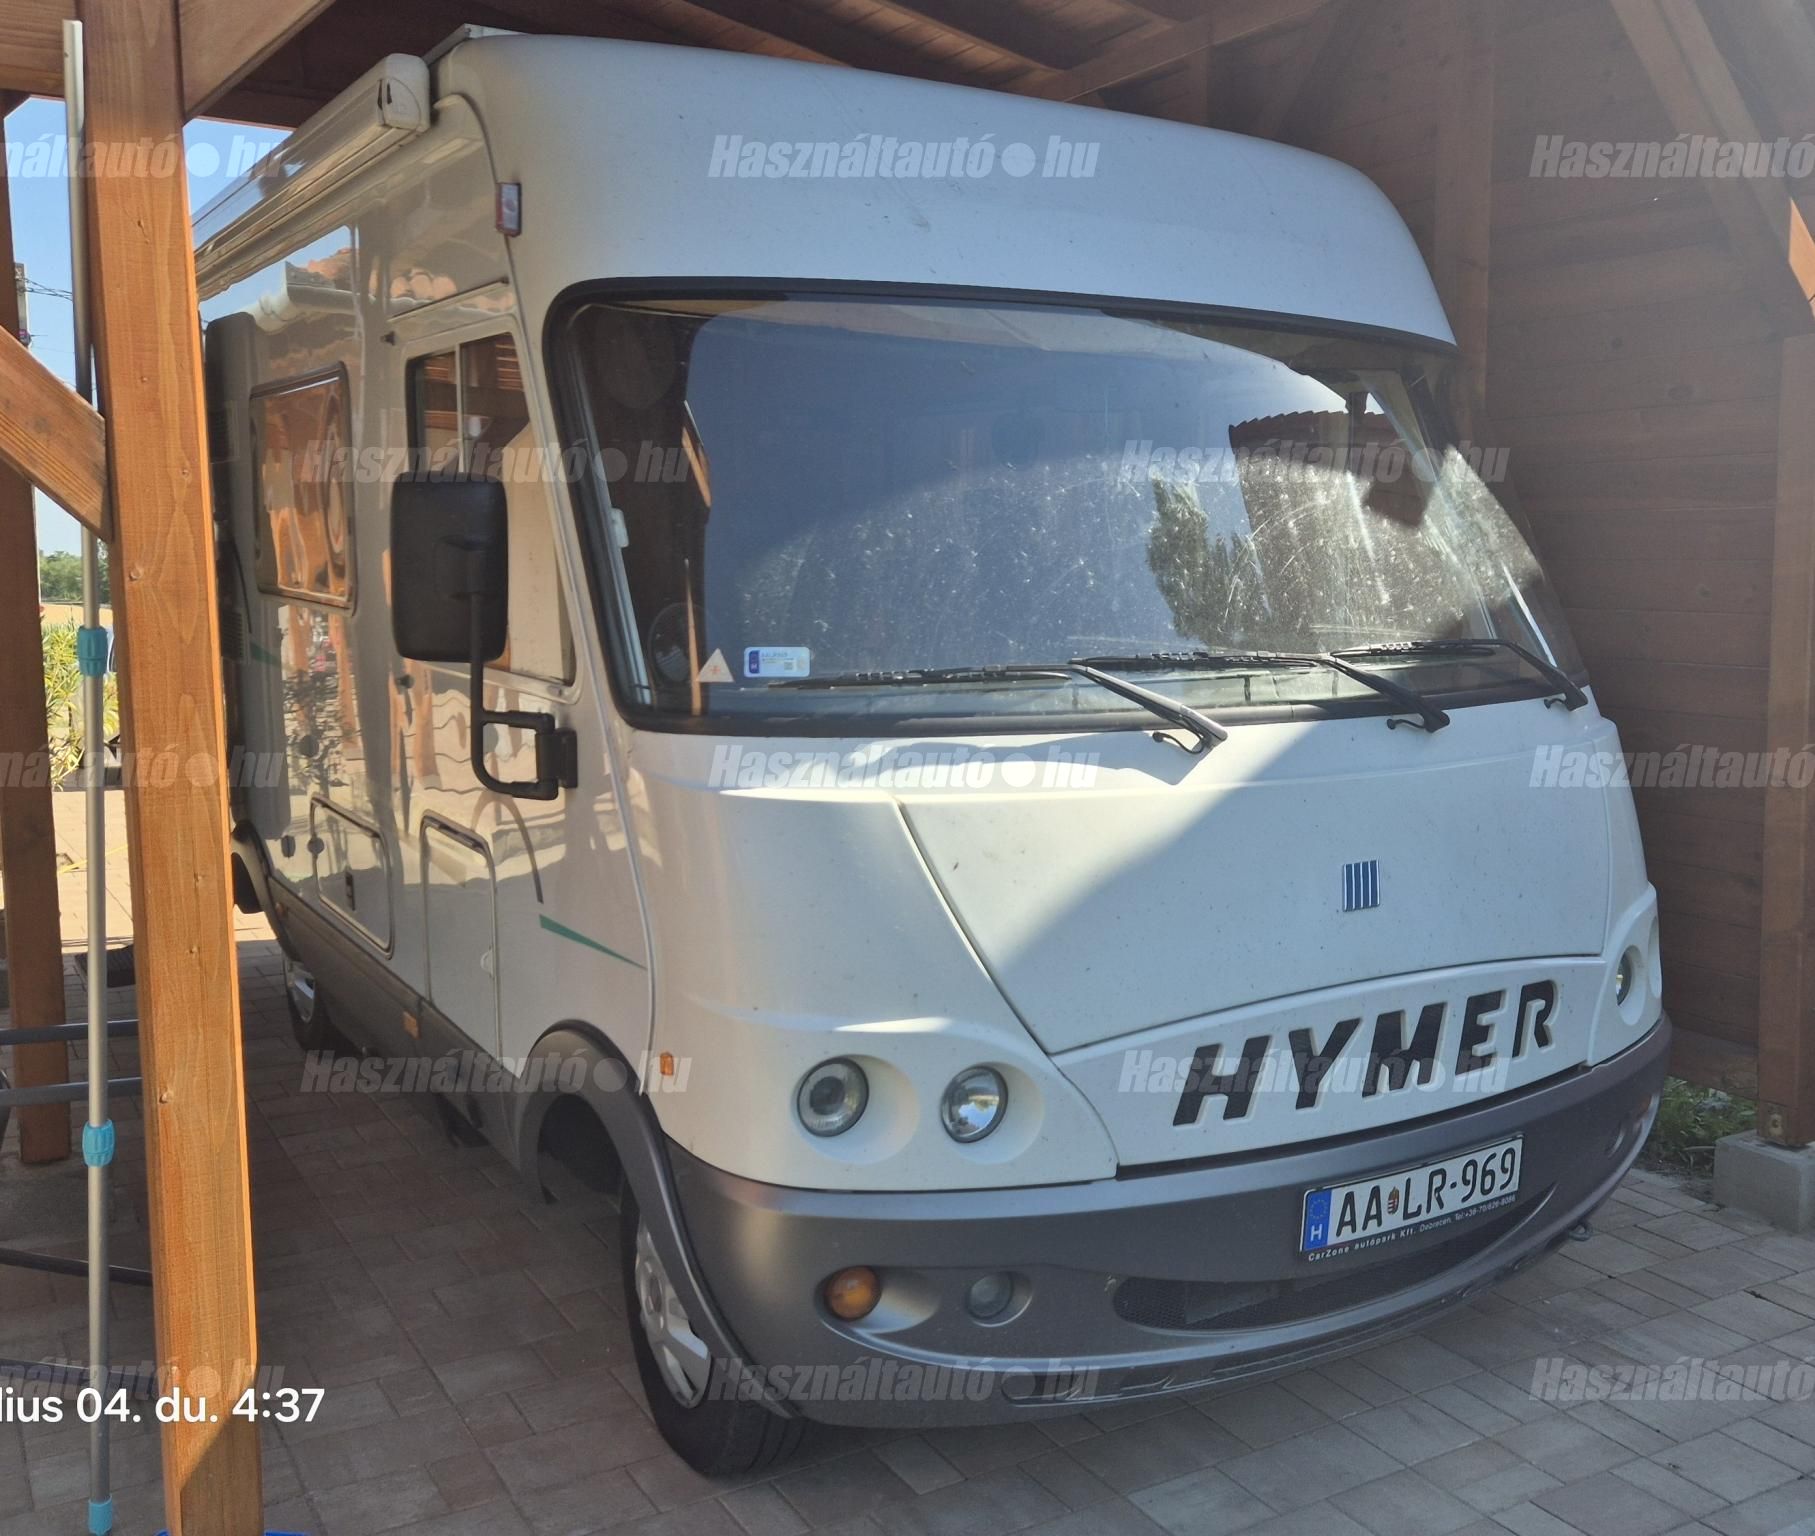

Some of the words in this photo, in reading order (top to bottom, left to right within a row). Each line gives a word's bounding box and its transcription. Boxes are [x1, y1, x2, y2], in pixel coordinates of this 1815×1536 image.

[1172, 979, 1559, 1127] HYMER
[1310, 1223, 1322, 1241] H
[1308, 1246, 1350, 1262] CarZone
[1354, 1233, 1396, 1250] autópark
